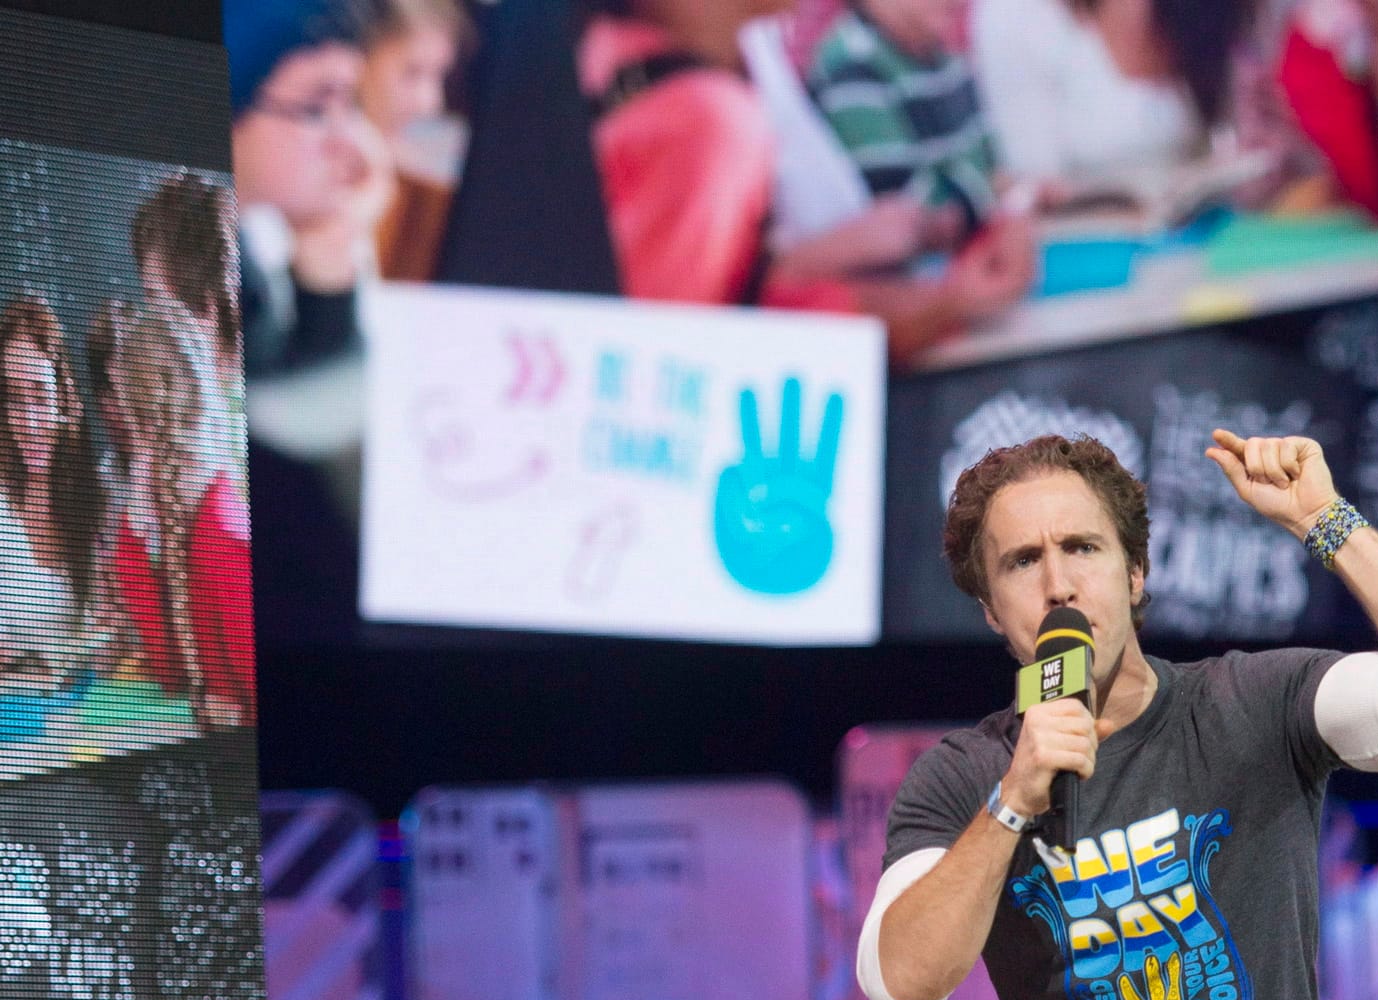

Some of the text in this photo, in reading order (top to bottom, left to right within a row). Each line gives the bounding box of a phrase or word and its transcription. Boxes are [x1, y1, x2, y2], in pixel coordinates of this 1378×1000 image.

[1043, 660, 1061, 677] WE
[1043, 675, 1061, 690] DAY
[1033, 808, 1189, 918] WE
[1069, 882, 1217, 979] DAY
[1184, 949, 1205, 1000] YOUR
